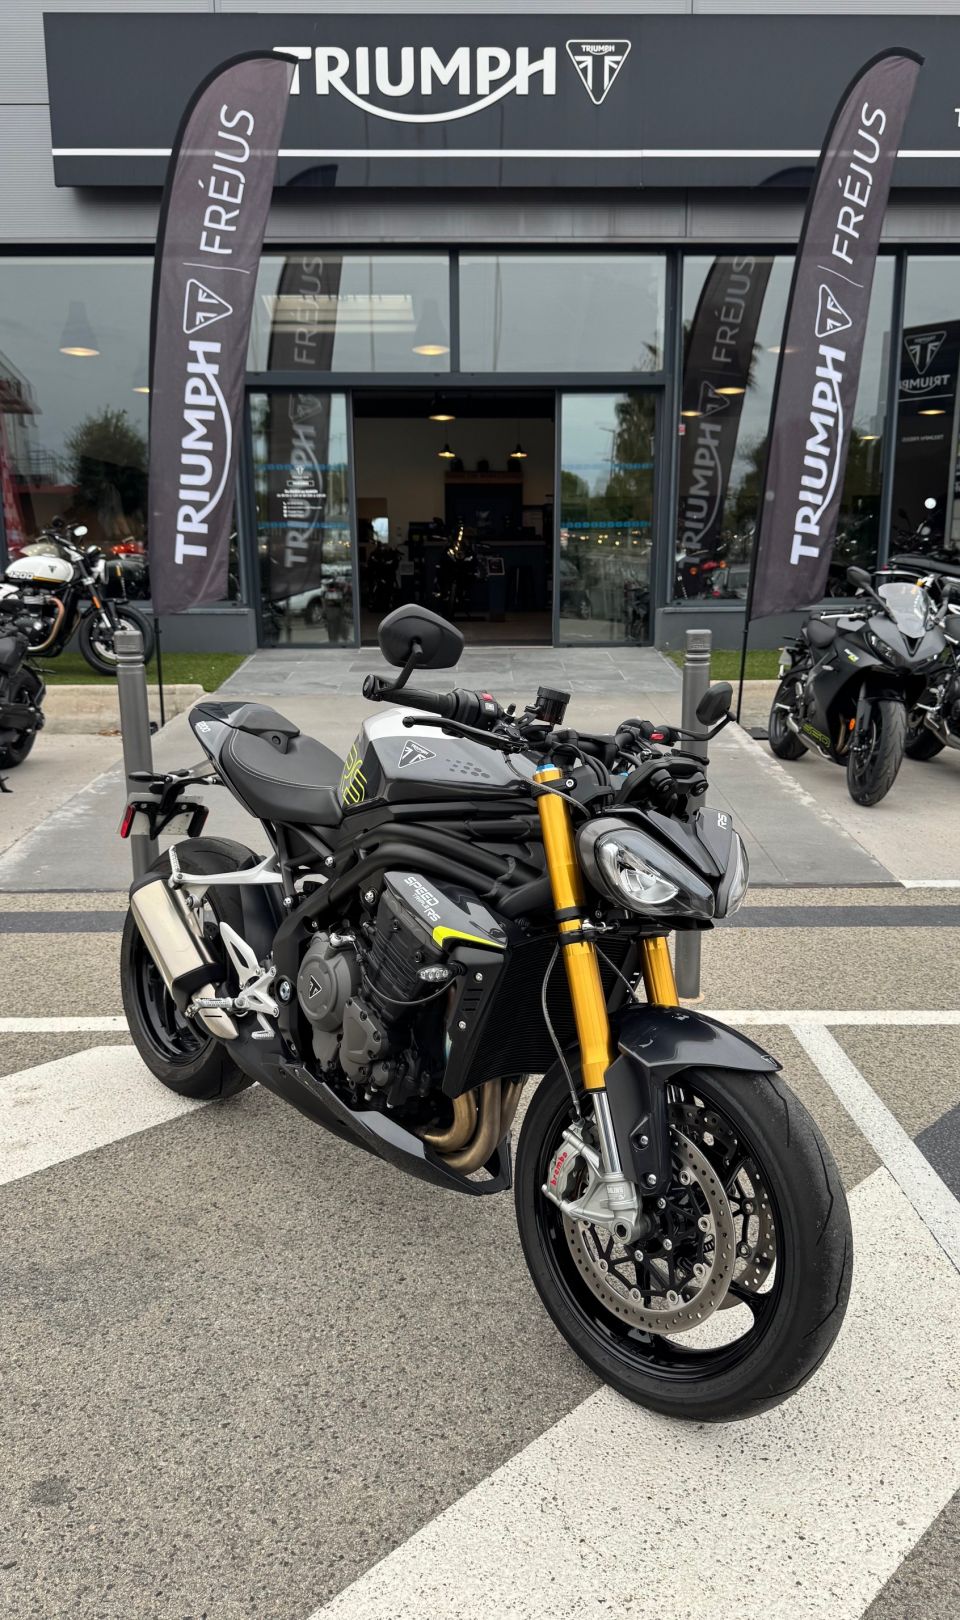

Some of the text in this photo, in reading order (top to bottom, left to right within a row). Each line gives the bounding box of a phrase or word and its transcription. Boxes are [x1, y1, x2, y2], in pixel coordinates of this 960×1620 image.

[581, 44, 616, 55] TRIUMPH
[272, 46, 557, 123] TRIUMPH
[711, 256, 756, 364] FRÉJUS
[174, 104, 255, 565] TRIUMPH FRÉJUS
[789, 102, 887, 566] TRIUMPH FRÉJUS
[717, 812, 728, 830] RS
[403, 876, 440, 907] SPEED
[412, 892, 441, 922] TRIPLE RS
[550, 1151, 568, 1186] brembo
